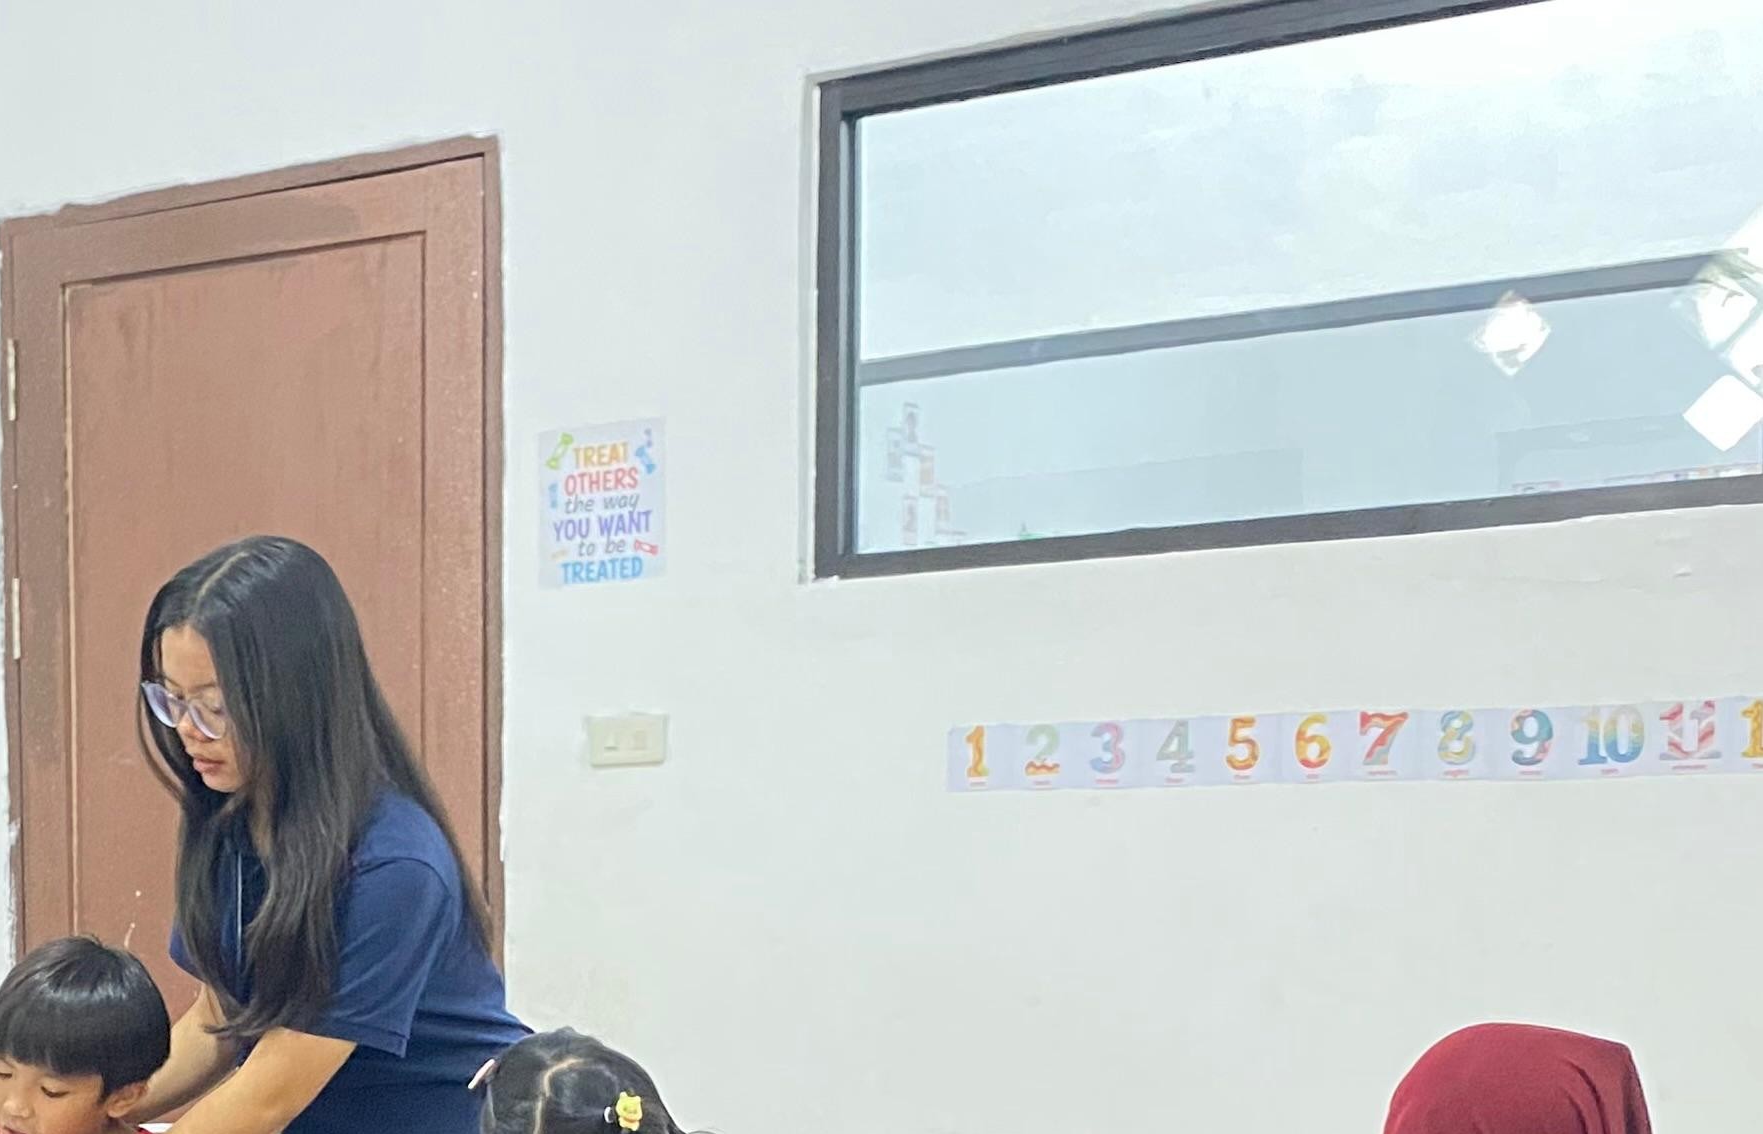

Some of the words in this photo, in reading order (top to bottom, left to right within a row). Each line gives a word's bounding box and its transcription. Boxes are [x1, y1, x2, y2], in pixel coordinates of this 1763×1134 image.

[574, 442, 628, 467] TREAT
[565, 468, 638, 496] OTHERS
[565, 494, 595, 514] the
[603, 493, 640, 513] way
[554, 519, 589, 541] YOU
[599, 511, 652, 536] WANT
[578, 540, 596, 557] to
[605, 535, 626, 554] be
[562, 557, 642, 584] TREATED
[964, 724, 989, 778] 1
[1024, 723, 1061, 776] 2
[1089, 721, 1126, 774] 3
[1156, 719, 1196, 774] 4
[1223, 715, 1260, 771] 5
[1295, 712, 1332, 769] 6
[1359, 711, 1409, 766] 7
[1437, 710, 1475, 766] 8
[1510, 708, 1554, 767] 9
[1577, 706, 1644, 766] 10
